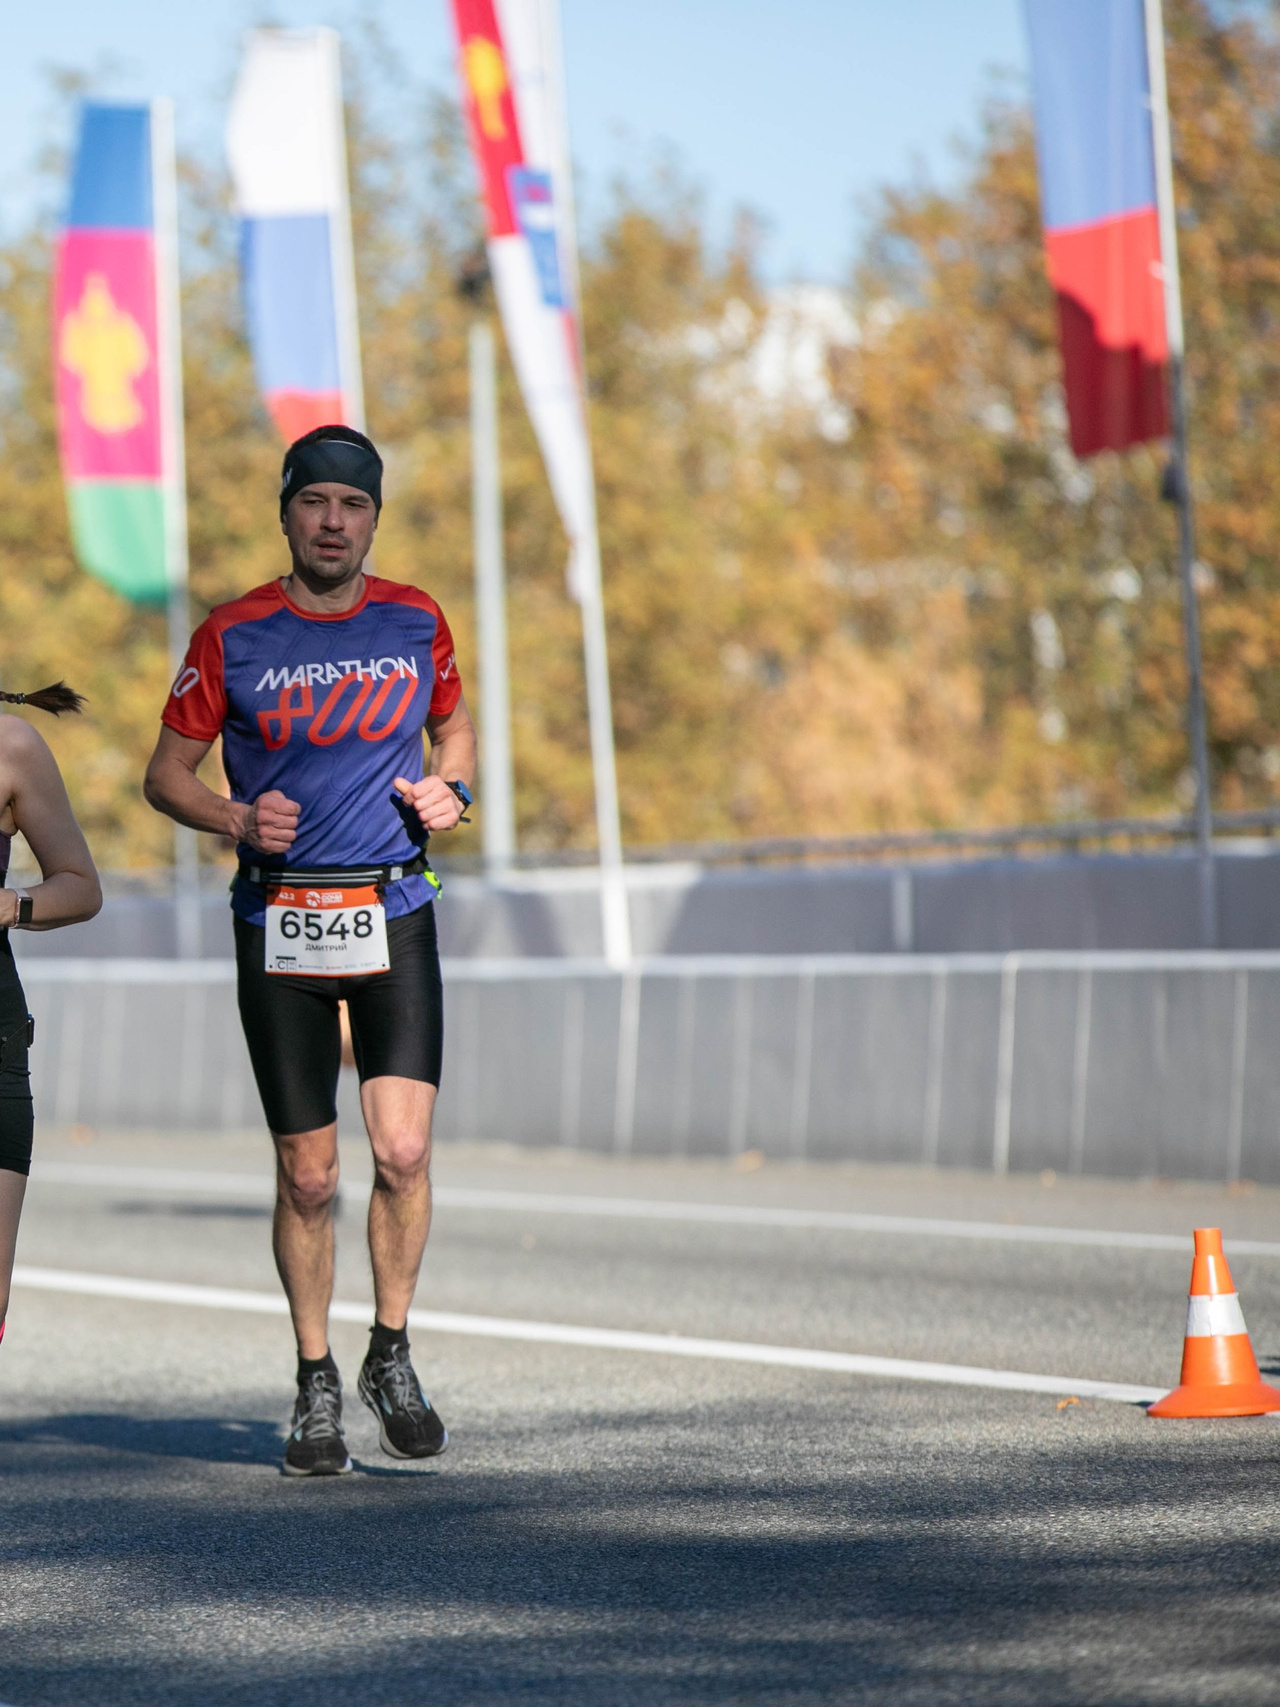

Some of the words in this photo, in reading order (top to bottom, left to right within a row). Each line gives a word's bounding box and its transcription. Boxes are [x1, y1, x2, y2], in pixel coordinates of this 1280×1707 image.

[254, 656, 418, 692] MARATHON
[280, 909, 374, 941] 6548
[305, 943, 348, 951] ДМИТРИЙ
